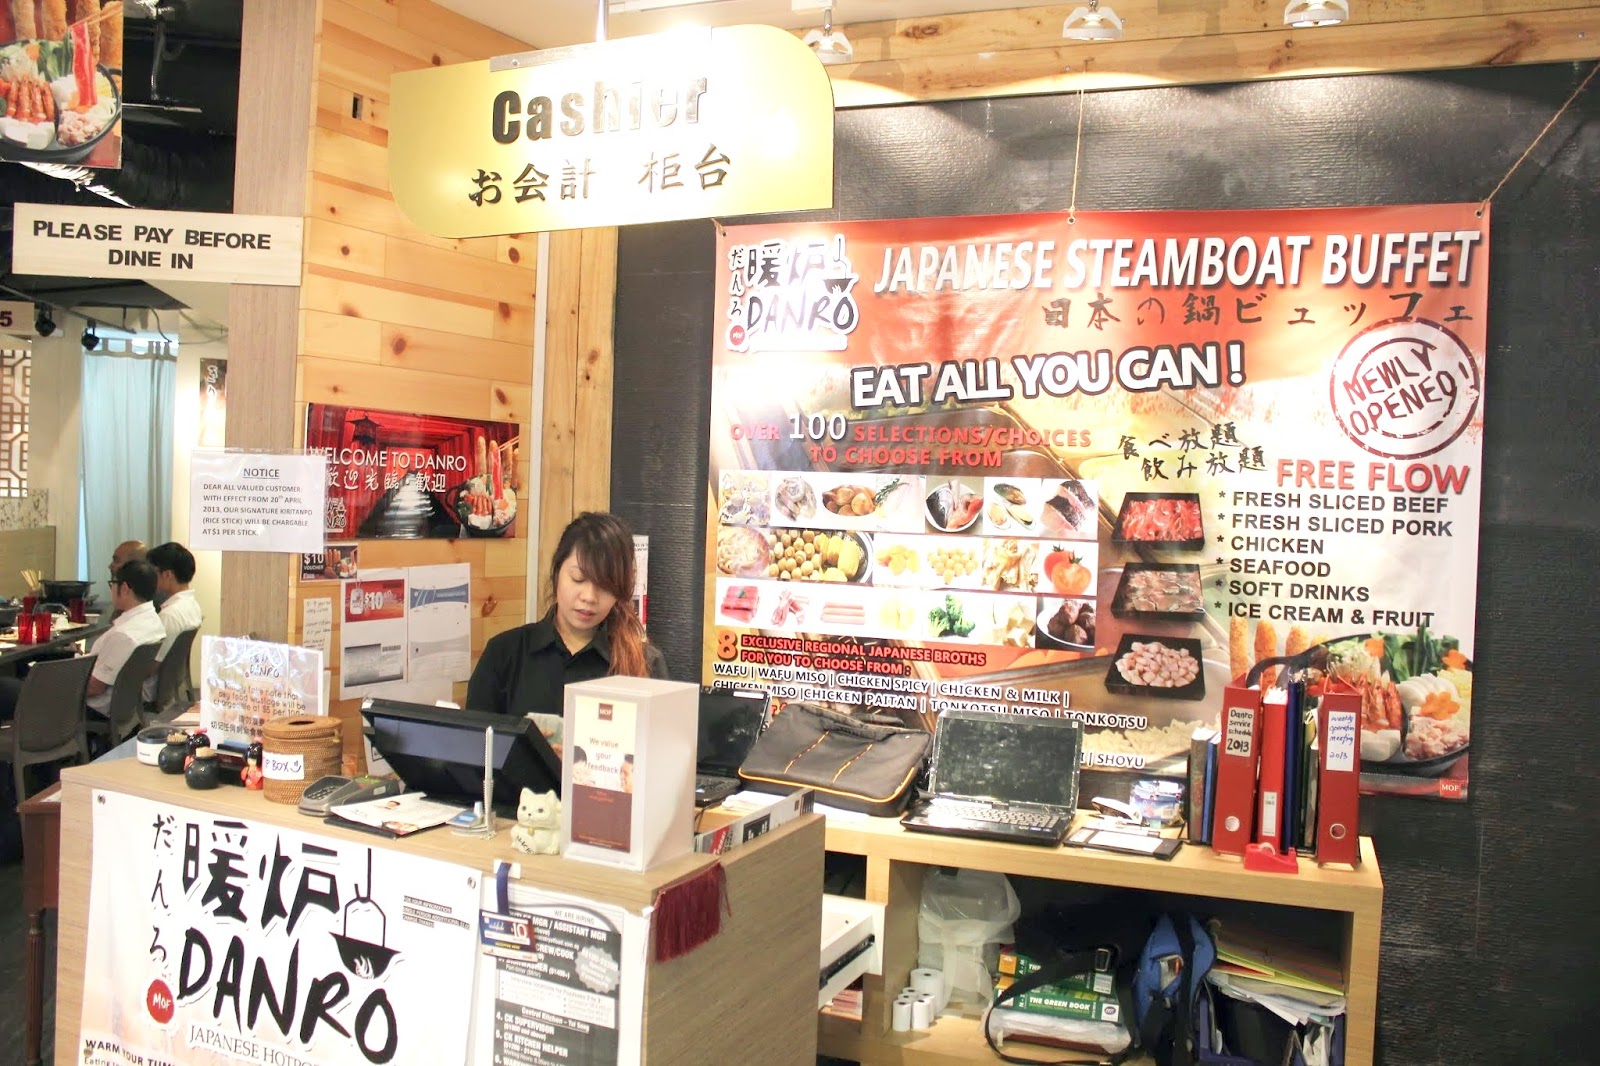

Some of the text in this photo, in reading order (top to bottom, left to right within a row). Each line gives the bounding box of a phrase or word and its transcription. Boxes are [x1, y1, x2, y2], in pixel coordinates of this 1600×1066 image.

[492, 77, 707, 144] Cashier
[468, 143, 731, 207] お会計 柜台
[33, 220, 271, 250] PLEASE PAY BEFORE
[108, 249, 193, 269] DINE IN
[874, 229, 1482, 294] JAPANESE STEAMBOAT BUFFET
[747, 295, 855, 332] DANRO
[851, 362, 929, 408] EAT
[934, 358, 1012, 402] ALL
[1013, 350, 1112, 398] YOU
[1343, 344, 1437, 406] NEWLY
[730, 413, 1092, 447] OVER 100 SELECTIONS/CHOICES
[391, 451, 410, 470] TO
[414, 454, 467, 471] DANRO
[811, 446, 1001, 468] TO CHOOSE FROM
[243, 468, 280, 478] NOTICE
[1276, 458, 1470, 495] FREE FLOW
[1233, 491, 1449, 514] FRESH SLICED BEEF
[271, 519, 308, 527] CHARGABLE
[1232, 513, 1453, 537] FRESH SLICED PORK
[1231, 536, 1324, 555] CHICKEN
[1229, 558, 1331, 577] SEAFOOD
[1229, 580, 1370, 602] SOFT DRINKS
[1228, 602, 1435, 628] ICE CREAM & FRUIT
[717, 630, 738, 660] 8
[741, 635, 986, 666] EXCLUSIVE REGIONAL JAPANESE BROTHS
[741, 651, 765, 664] FOR
[767, 653, 791, 666] YOU
[794, 655, 811, 667] TO
[814, 657, 863, 672] CHOOSE
[714, 664, 1059, 704] WAFU WAFU MISO CHICKEN SPICY CHICKEN & MILK
[767, 685, 797, 697] MISO
[804, 689, 861, 704] CHICKEN
[866, 694, 916, 709] PAITAN
[1230, 709, 1253, 719] Danro
[589, 737, 619, 749] We value
[1227, 738, 1250, 752] 2013
[595, 753, 612, 761] your
[1097, 753, 1145, 769] SHOYU
[587, 762, 619, 775] feedback
[150, 812, 178, 965] だんろ
[182, 820, 341, 937] 暖炉
[553, 920, 590, 938] ASSISTANT
[590, 929, 607, 942] MGR
[177, 927, 399, 1065] DANRO
[1029, 997, 1043, 1005] THE
[1044, 998, 1067, 1008] GREEN
[1069, 1002, 1090, 1011] BOOK
[515, 1016, 555, 1035] SUPERVISOR
[86, 1039, 120, 1056] WARM
[189, 1025, 260, 1059] JAPANESE
[542, 1043, 569, 1058] HELPER
